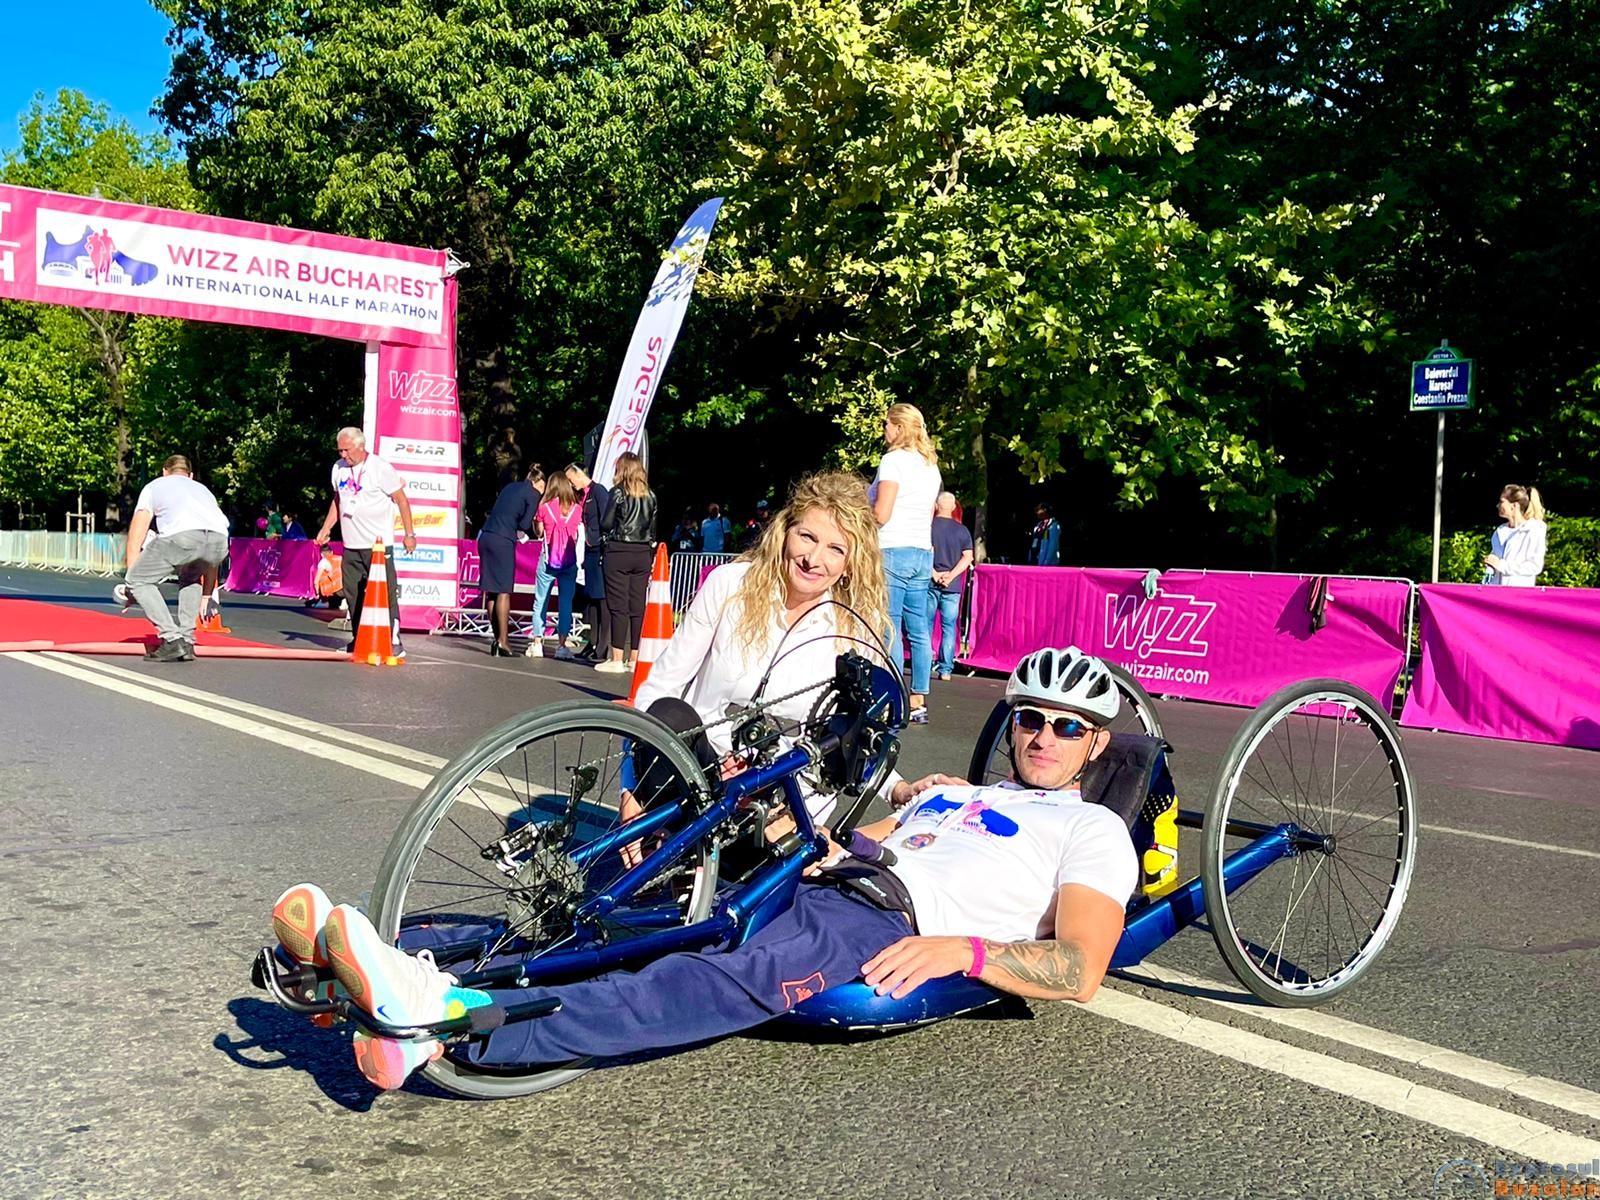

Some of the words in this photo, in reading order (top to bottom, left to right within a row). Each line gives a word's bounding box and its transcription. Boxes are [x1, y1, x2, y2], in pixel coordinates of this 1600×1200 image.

[167, 244, 238, 273] WIZZ
[246, 256, 290, 280] AIR
[297, 262, 438, 300] BUCHAREST
[166, 274, 303, 302] INTERNATIONAL
[308, 292, 349, 308] HALF
[355, 298, 438, 321] MARATHON
[613, 336, 662, 466] ROEDUS
[400, 405, 457, 417] wizzair.com
[395, 443, 445, 456] POLAR
[394, 549, 441, 561] ECATHLON
[404, 584, 441, 596] AQUA
[1120, 659, 1210, 685] wizzair.com
